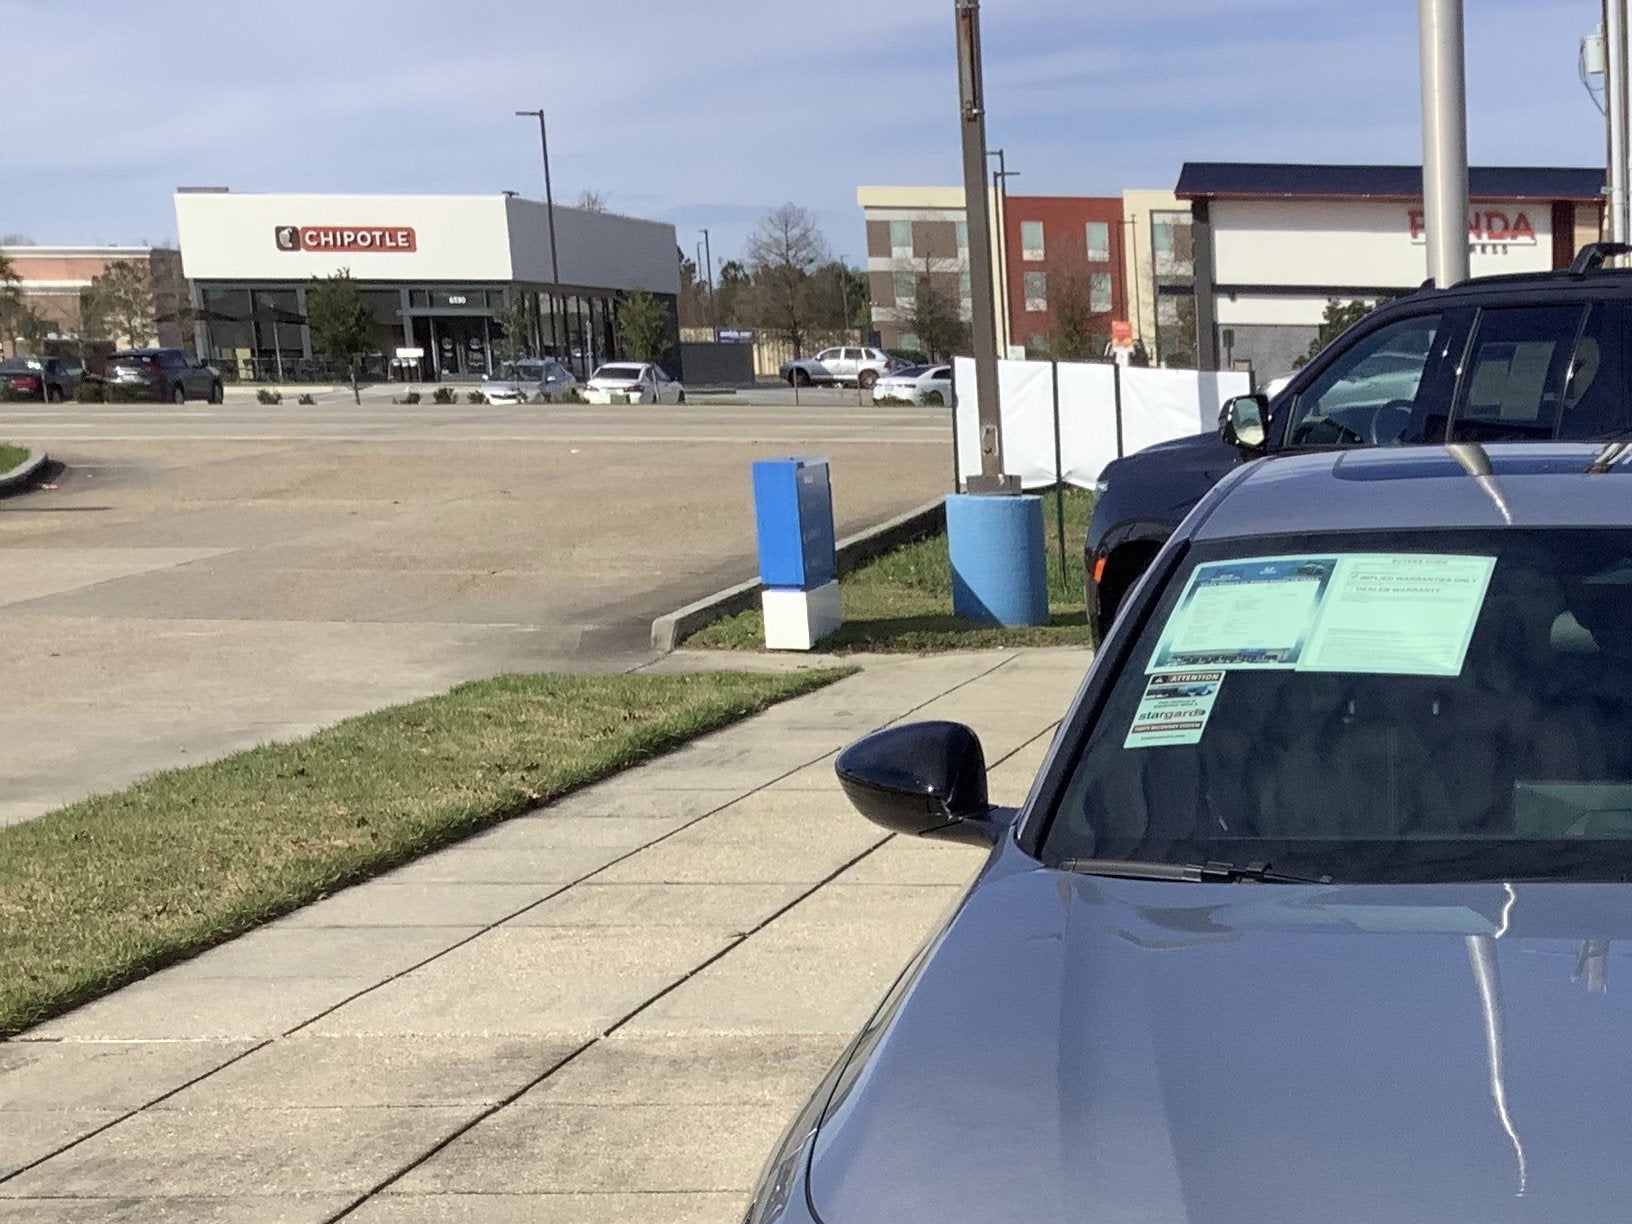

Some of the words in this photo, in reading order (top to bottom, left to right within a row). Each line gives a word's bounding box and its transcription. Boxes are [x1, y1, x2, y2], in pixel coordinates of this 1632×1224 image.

[1408, 209, 1537, 240] PNDA
[304, 231, 410, 248] CHIPOTLE
[1169, 674, 1220, 682] ATTENTION
